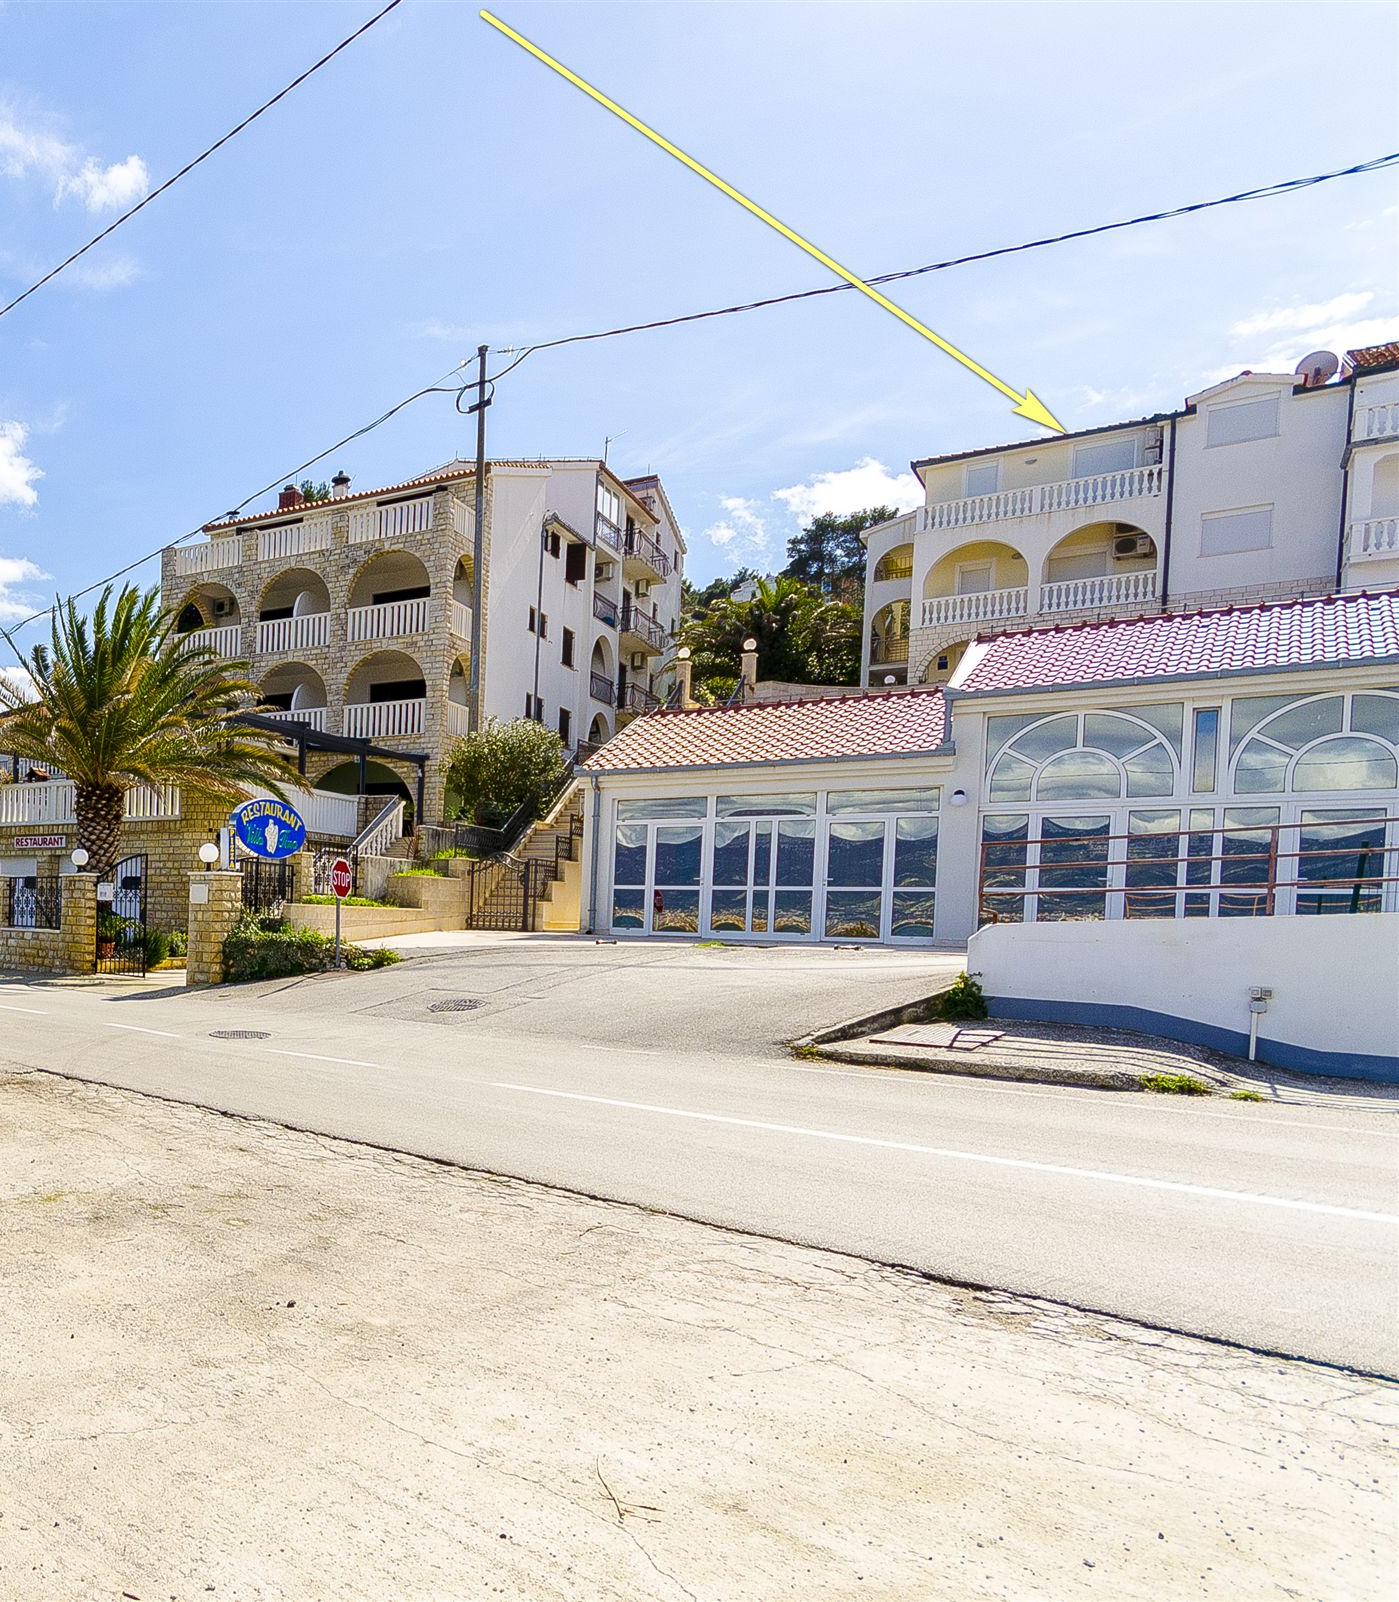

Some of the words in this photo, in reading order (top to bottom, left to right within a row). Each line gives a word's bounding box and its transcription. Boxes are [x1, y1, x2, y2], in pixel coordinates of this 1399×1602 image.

[241, 801, 302, 831] RESTAURANT
[15, 836, 64, 847] RESTAURANT
[333, 870, 350, 887] STOP
